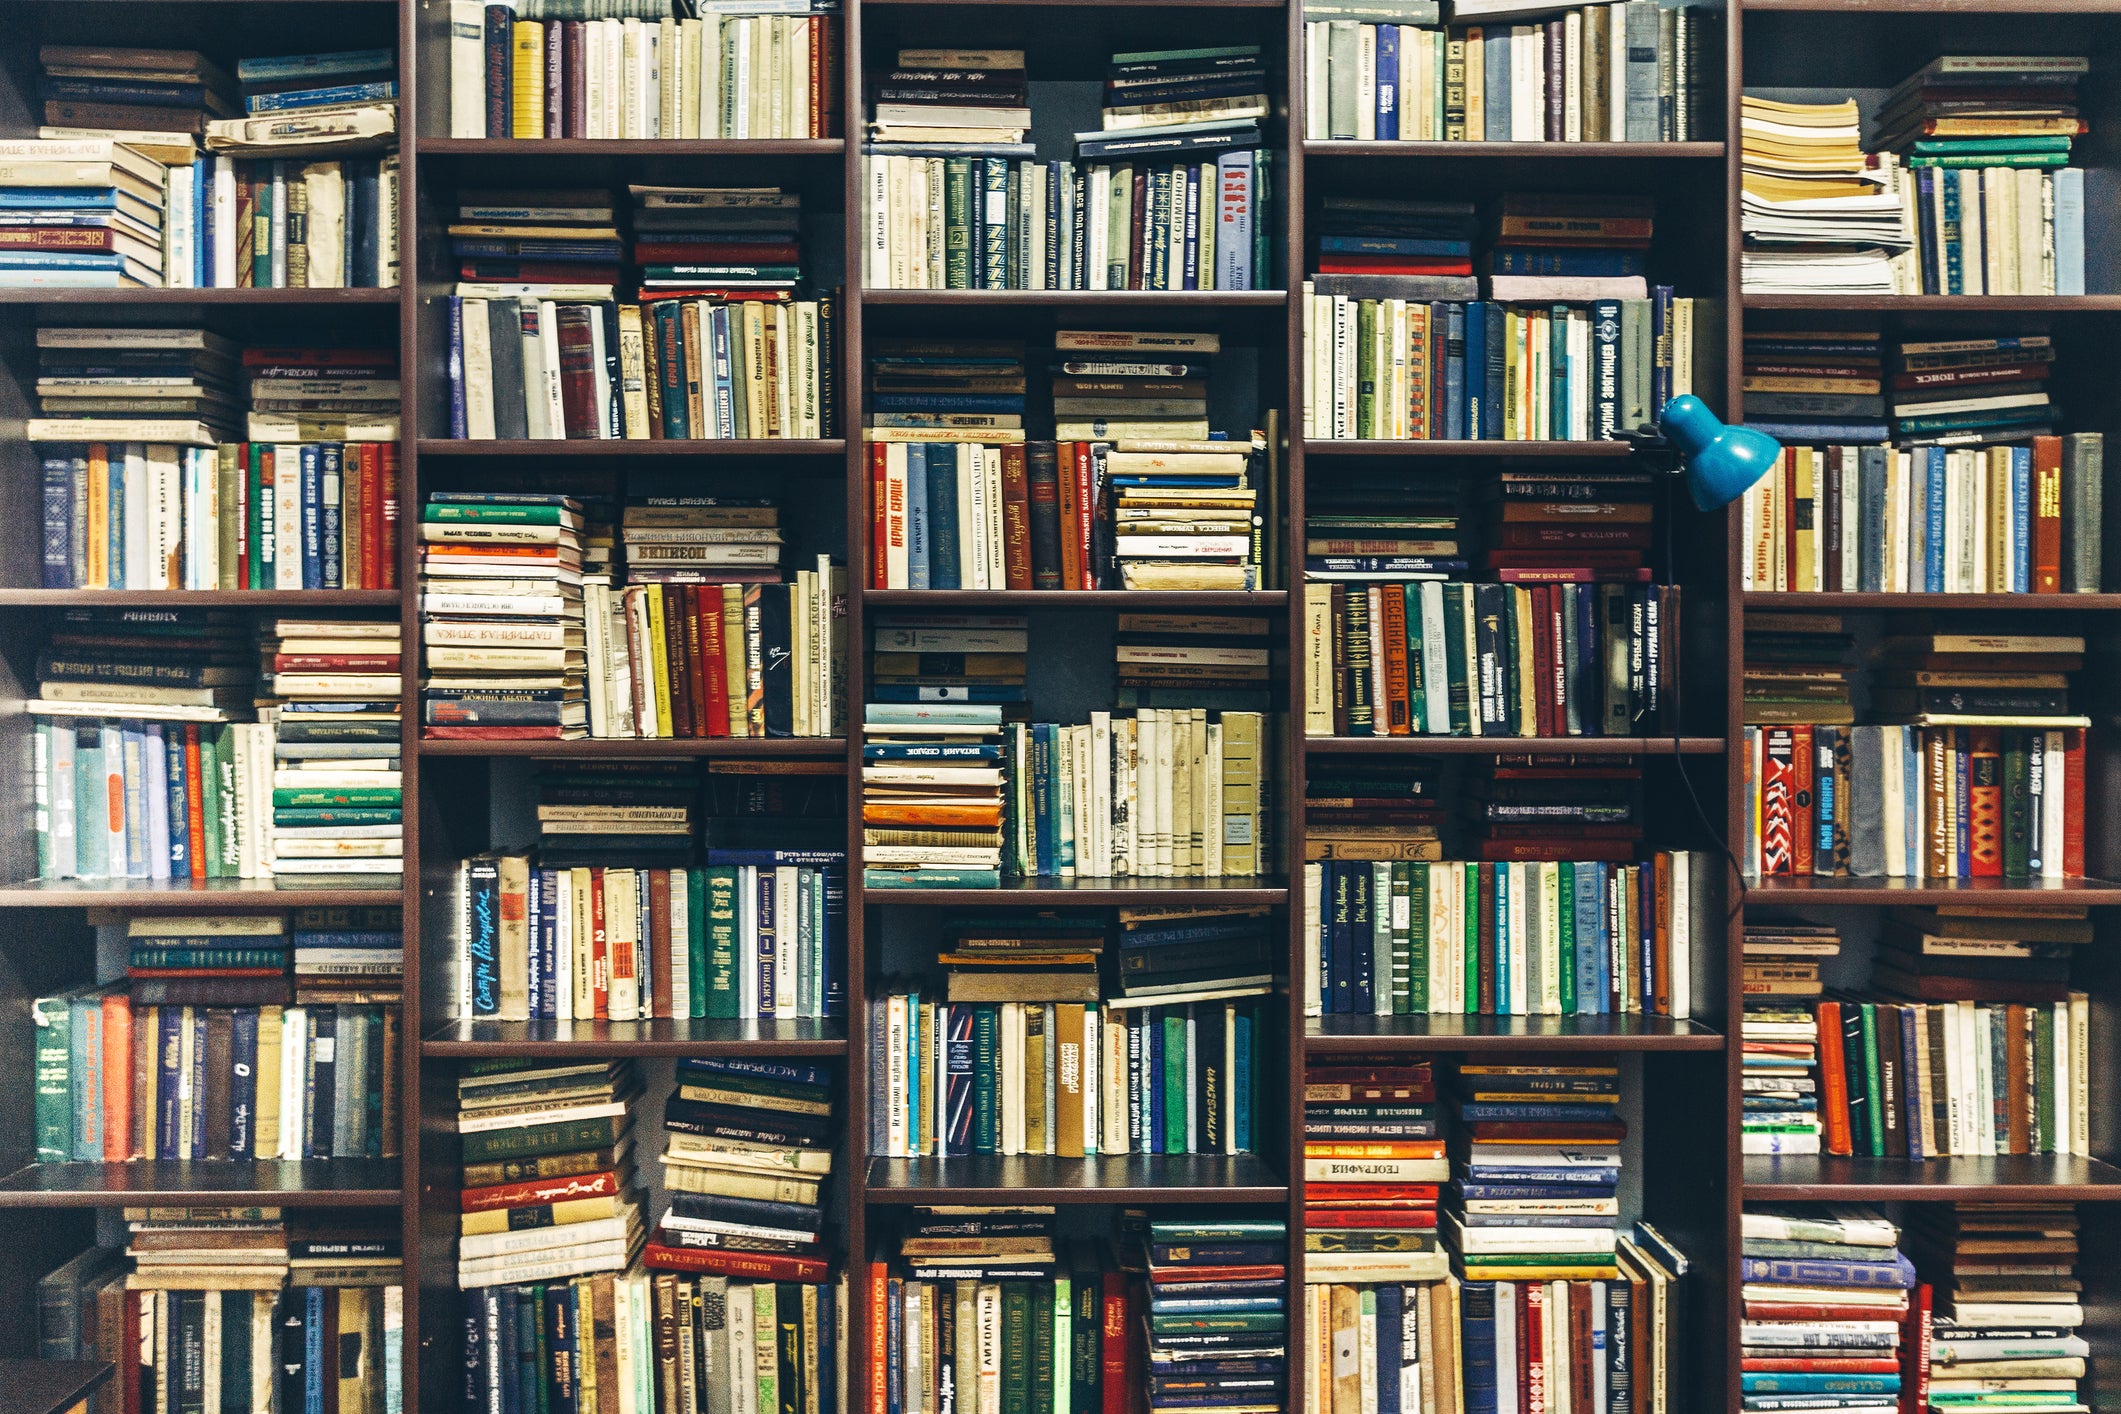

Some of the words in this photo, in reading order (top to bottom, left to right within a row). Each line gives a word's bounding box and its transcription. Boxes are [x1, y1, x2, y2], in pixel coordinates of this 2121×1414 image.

[1552, 39, 1561, 70] МОГЛИ
[1552, 74, 1560, 92] ЧТО
[877, 173, 885, 202] ЖИЗНЬ
[1022, 166, 1031, 206] Н.СИЗОВ
[1077, 177, 1083, 192] МЫ
[877, 211, 885, 249] ВПЕРЕДИ
[1022, 213, 1030, 236] ЗАЧЕМ
[1048, 218, 1056, 259] ВОЕННАЯ
[1022, 237, 1030, 251] МНЕ
[1074, 229, 1082, 290] ПОДОЗРЕНИЕМ
[1048, 261, 1056, 289] ВАХТА
[664, 317, 676, 361] ПОДПОЛЬЯ
[1337, 303, 1345, 348] ПЕРМЬ
[1664, 306, 1673, 359] ПОЛИТИКА
[1138, 338, 1177, 346] ХЭРРИОТ
[1656, 334, 1664, 368] ВОЙНА
[754, 338, 764, 380] Открыватели
[1600, 344, 1615, 398] ЗВЯГИНЦЕВ
[667, 363, 677, 389] ГЕРОИ
[1916, 373, 1956, 383] ПОИСК
[720, 389, 731, 439] ТЕЛЕШОВ
[989, 416, 996, 426] В.
[305, 454, 316, 504] БЕРЕЗКО
[1063, 465, 1071, 515] ПОКУШЕНИЕ
[1080, 462, 1088, 486] ВЕСНЫ
[1932, 457, 1943, 504] РАССВЕТУ
[2017, 457, 2028, 504] РАССВЕТУ
[889, 478, 903, 512] СЕРДЦЕ
[914, 506, 922, 514] Ф.
[1932, 504, 1942, 512] К
[2017, 504, 2027, 512] К
[307, 508, 318, 557] ГЕОРГИЙ
[890, 514, 903, 548] ВЕРНОЕ
[914, 516, 922, 553] АБРАМОВ
[1010, 505, 1026, 545] Казаков
[1083, 512, 1091, 542] ГОРЬКИЙ
[1757, 540, 1767, 582] ЖИЗНЬ
[1762, 487, 1773, 529] БОРЬБЕ
[1932, 513, 1943, 547] БЛИЖЕ
[2017, 513, 2028, 547] БЛИЖЕ
[637, 546, 707, 559] ПОЗИЦИЯ
[1253, 528, 1262, 564] ЯПОНИЯ
[1012, 548, 1029, 579] Юрий
[749, 606, 760, 632] ГРЕХОВ
[1369, 597, 1378, 609] ЭТО
[1369, 610, 1378, 621] НЕ
[1647, 599, 1657, 625] СИЛА
[436, 630, 478, 640] ЭТИКА
[480, 630, 552, 640] ПАРТИЙНАЯ
[810, 593, 820, 664] ИГОРЬ-ЯКОРЬ
[1387, 591, 1405, 657] ВЕСЕННИЕ
[1632, 603, 1642, 636] ЛЕБЕДИ
[749, 633, 761, 669] СМЕРТНЫХ
[1370, 621, 1380, 654] ДОЛЖНО
[1555, 612, 1563, 665] рассказывают
[1648, 627, 1657, 658] ГРУБАЯ
[750, 669, 761, 690] СЕМЬ
[1372, 655, 1383, 709] ПОВТОРИТЬСЯ!
[1389, 659, 1406, 697] ВЕТРЫ
[1557, 667, 1566, 706] ЧЕКИСТЫ
[906, 747, 940, 756] СЕРДЮК
[2031, 765, 2043, 795] ЛЕОНИД
[1821, 776, 1833, 821] СЫНОВЬЯ
[1821, 824, 1833, 850] НОЧИ
[1934, 796, 1947, 856] А.А.Громыко
[1544, 845, 1572, 855] АХМЕТ
[763, 880, 771, 925] избранное
[1375, 873, 1390, 934] ГРАНИЦА
[1562, 876, 1572, 905] КОНИ
[1610, 878, 1619, 908] ПОХОДАХ
[594, 929, 606, 943] 2
[1411, 887, 1424, 959] Н.А.НЕКРАСОВ
[1611, 915, 1619, 930] БОЯХ
[1611, 938, 1620, 976] КИЛОМЕТРОВ
[762, 964, 771, 999] ЖУКОВ
[763, 999, 771, 1007] В.
[1130, 1028, 1140, 1059] ПОМОРЫ
[1061, 1043, 1070, 1085] ВАСИЛИЙ
[1069, 1043, 1080, 1094] ГРОССМАН
[892, 1086, 902, 1118] именами
[1334, 1108, 1370, 1116] АТАРОВ
[1376, 1108, 1423, 1116] НИКОЛАЙ
[1130, 1103, 1140, 1139] ГЕННАДИЙ
[1372, 1125, 1404, 1134] ВЕТРЫ
[1333, 1146, 1365, 1156] СТРАНЫ
[1331, 1164, 1399, 1175] ГЕОГРАФИЯ
[874, 1278, 885, 1300] края
[915, 1269, 937, 1278] НОЧИ
[937, 1269, 983, 1278] БЕССОННЫЕ
[718, 1294, 726, 1328] ФРОНТА
[874, 1301, 886, 1358] алмазного
[984, 1296, 993, 1366] ЛИХОЛЕТЬЕ
[874, 1362, 886, 1387] грани
